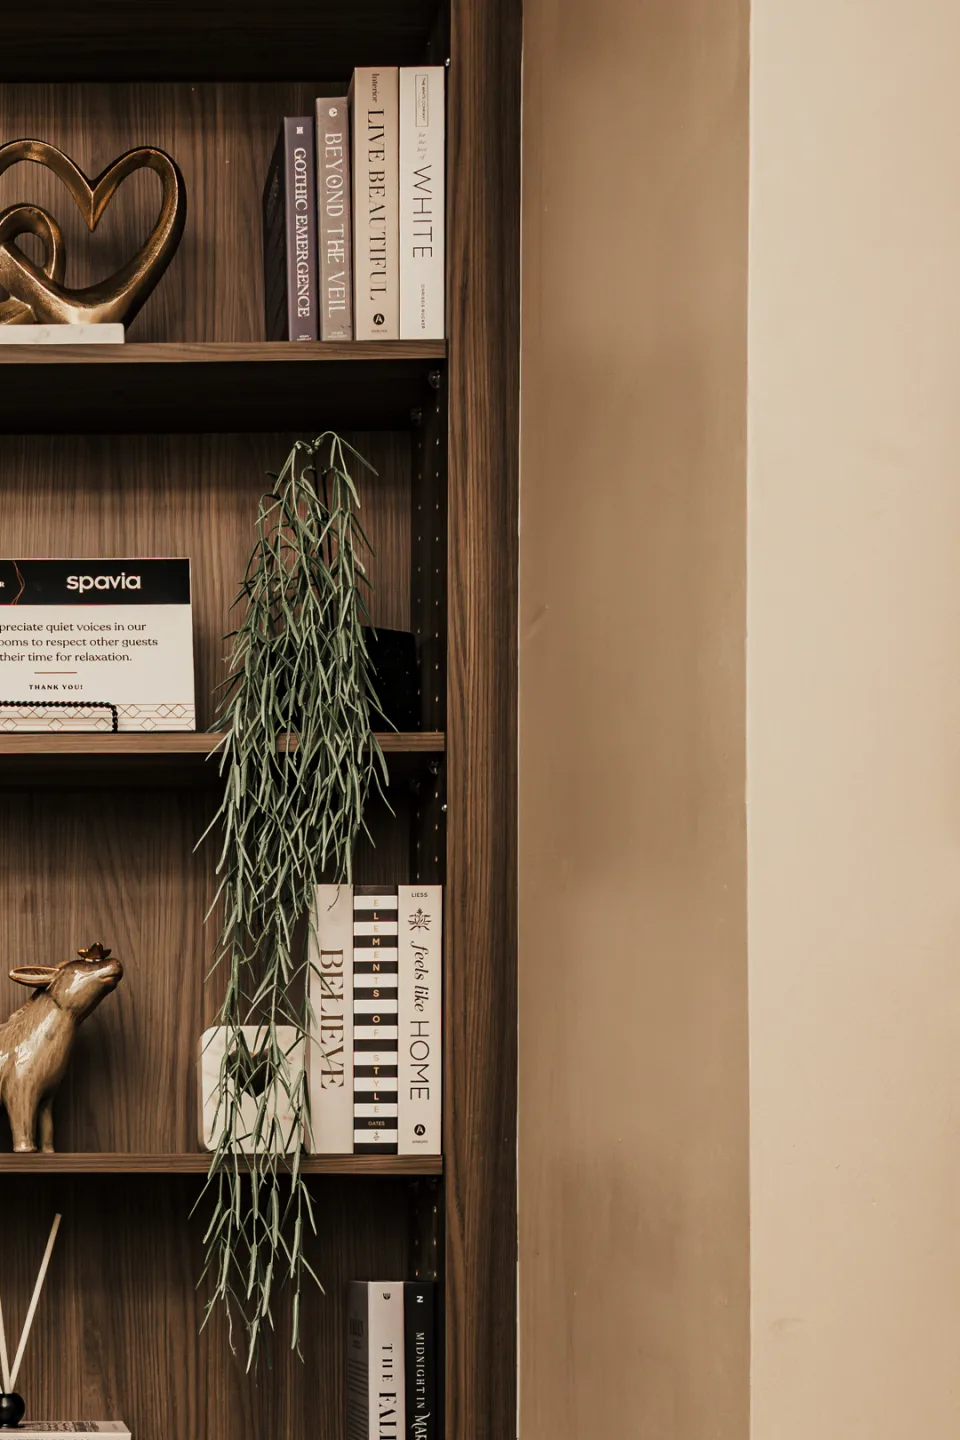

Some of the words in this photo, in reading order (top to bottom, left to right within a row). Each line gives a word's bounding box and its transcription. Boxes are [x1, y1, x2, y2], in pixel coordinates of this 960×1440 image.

[371, 73, 380, 102] Interior
[368, 109, 385, 162] LIVE
[294, 147, 308, 211] GOTHIC
[325, 133, 344, 217] BEYOND
[412, 164, 433, 258] WHITE
[327, 225, 345, 264] THE
[368, 170, 387, 301] BEAUTIFUL
[295, 214, 310, 317] EMERGENCE
[328, 271, 346, 318] VEIL
[66, 572, 141, 593] spavia
[31, 638, 43, 646] to
[46, 638, 86, 649] respect
[89, 637, 119, 646] other
[121, 638, 158, 649] guests
[46, 622, 74, 634] quiet
[76, 622, 112, 631] voices
[115, 622, 124, 631] in
[0, 653, 25, 661] their
[27, 653, 53, 661] time
[56, 652, 72, 661] for
[74, 652, 132, 661] relaxation.
[410, 941, 429, 980] feels
[320, 949, 345, 1089] BELIEVE
[414, 986, 429, 1012] like
[409, 1020, 430, 1100] HOME
[382, 1343, 393, 1382] THE
[415, 1332, 425, 1392] MIDNIGHT
[416, 1397, 425, 1409] IN
